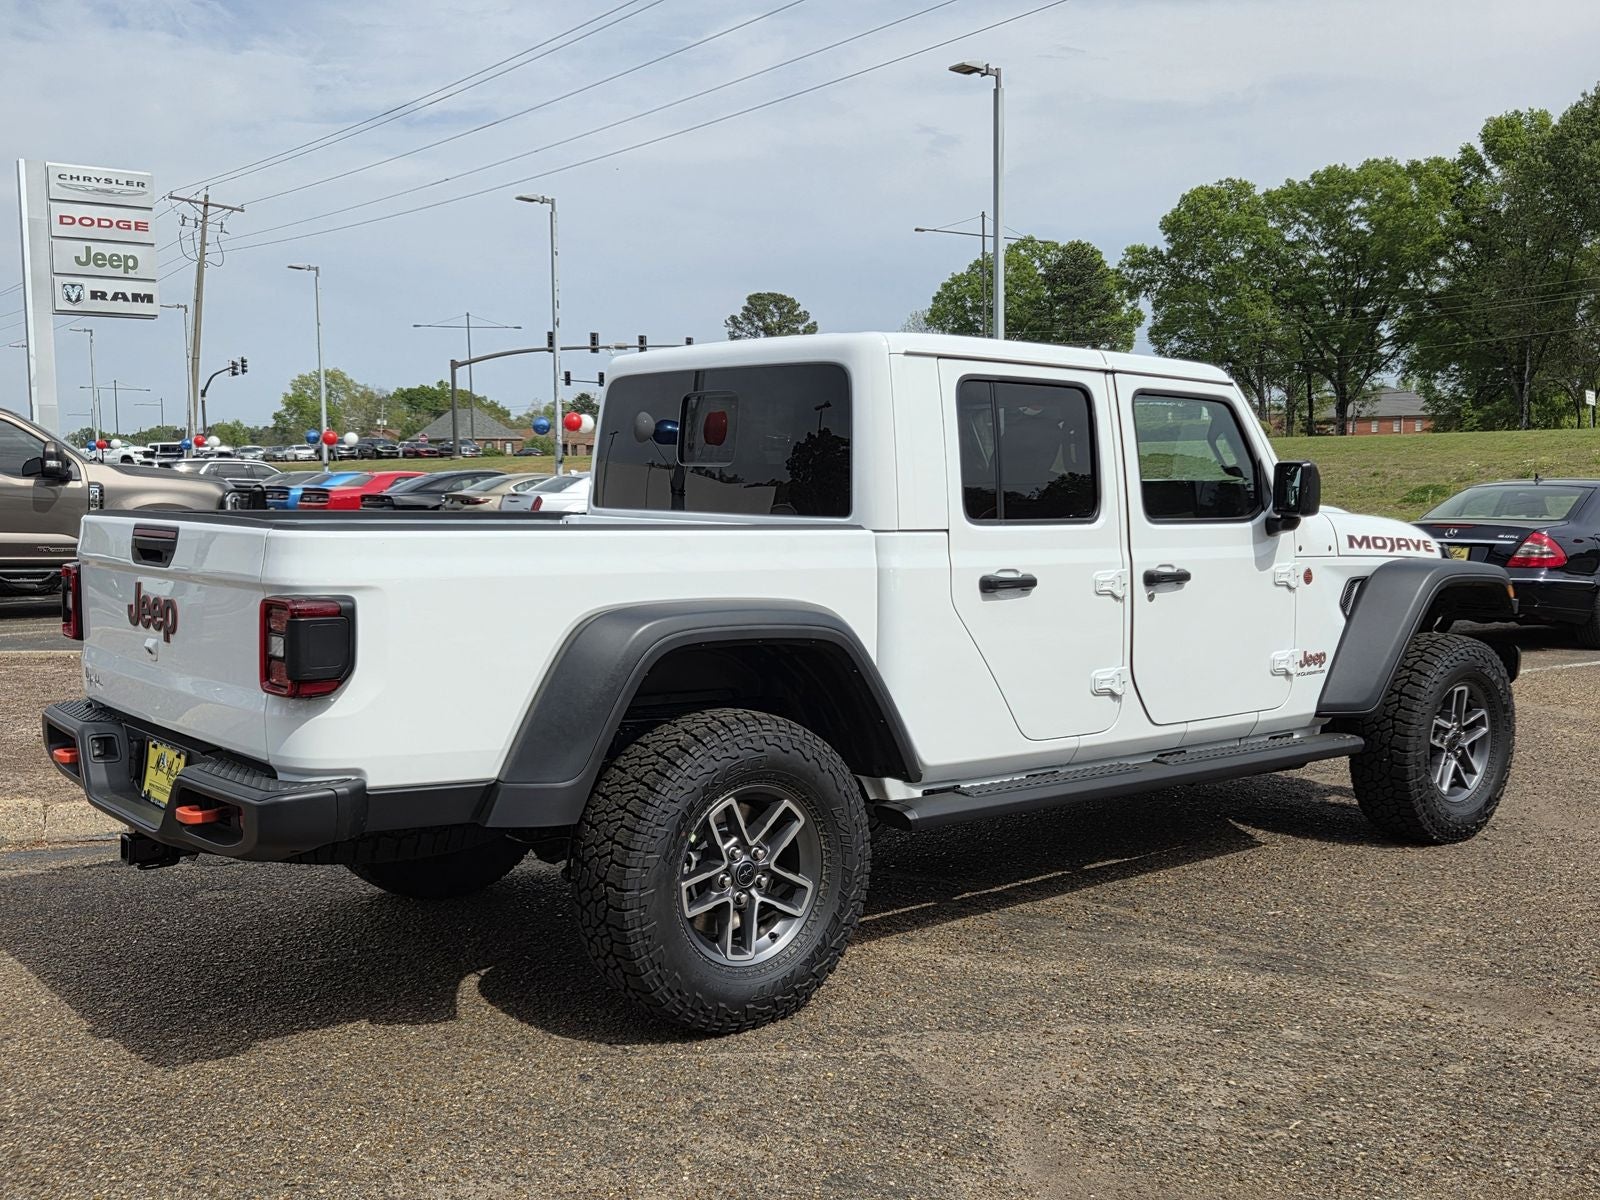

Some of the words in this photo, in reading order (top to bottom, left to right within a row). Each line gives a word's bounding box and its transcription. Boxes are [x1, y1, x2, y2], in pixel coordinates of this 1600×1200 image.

[57, 173, 146, 188] CHRYSLER
[58, 214, 149, 232] DODGE
[74, 245, 139, 274] Jeep
[89, 290, 154, 304] RAM
[1346, 534, 1435, 553] MOJAVE
[127, 581, 178, 643] Jeep
[1299, 650, 1326, 668] Jeep
[663, 753, 769, 866] FALKEN
[800, 806, 854, 974] WILDPEAK
